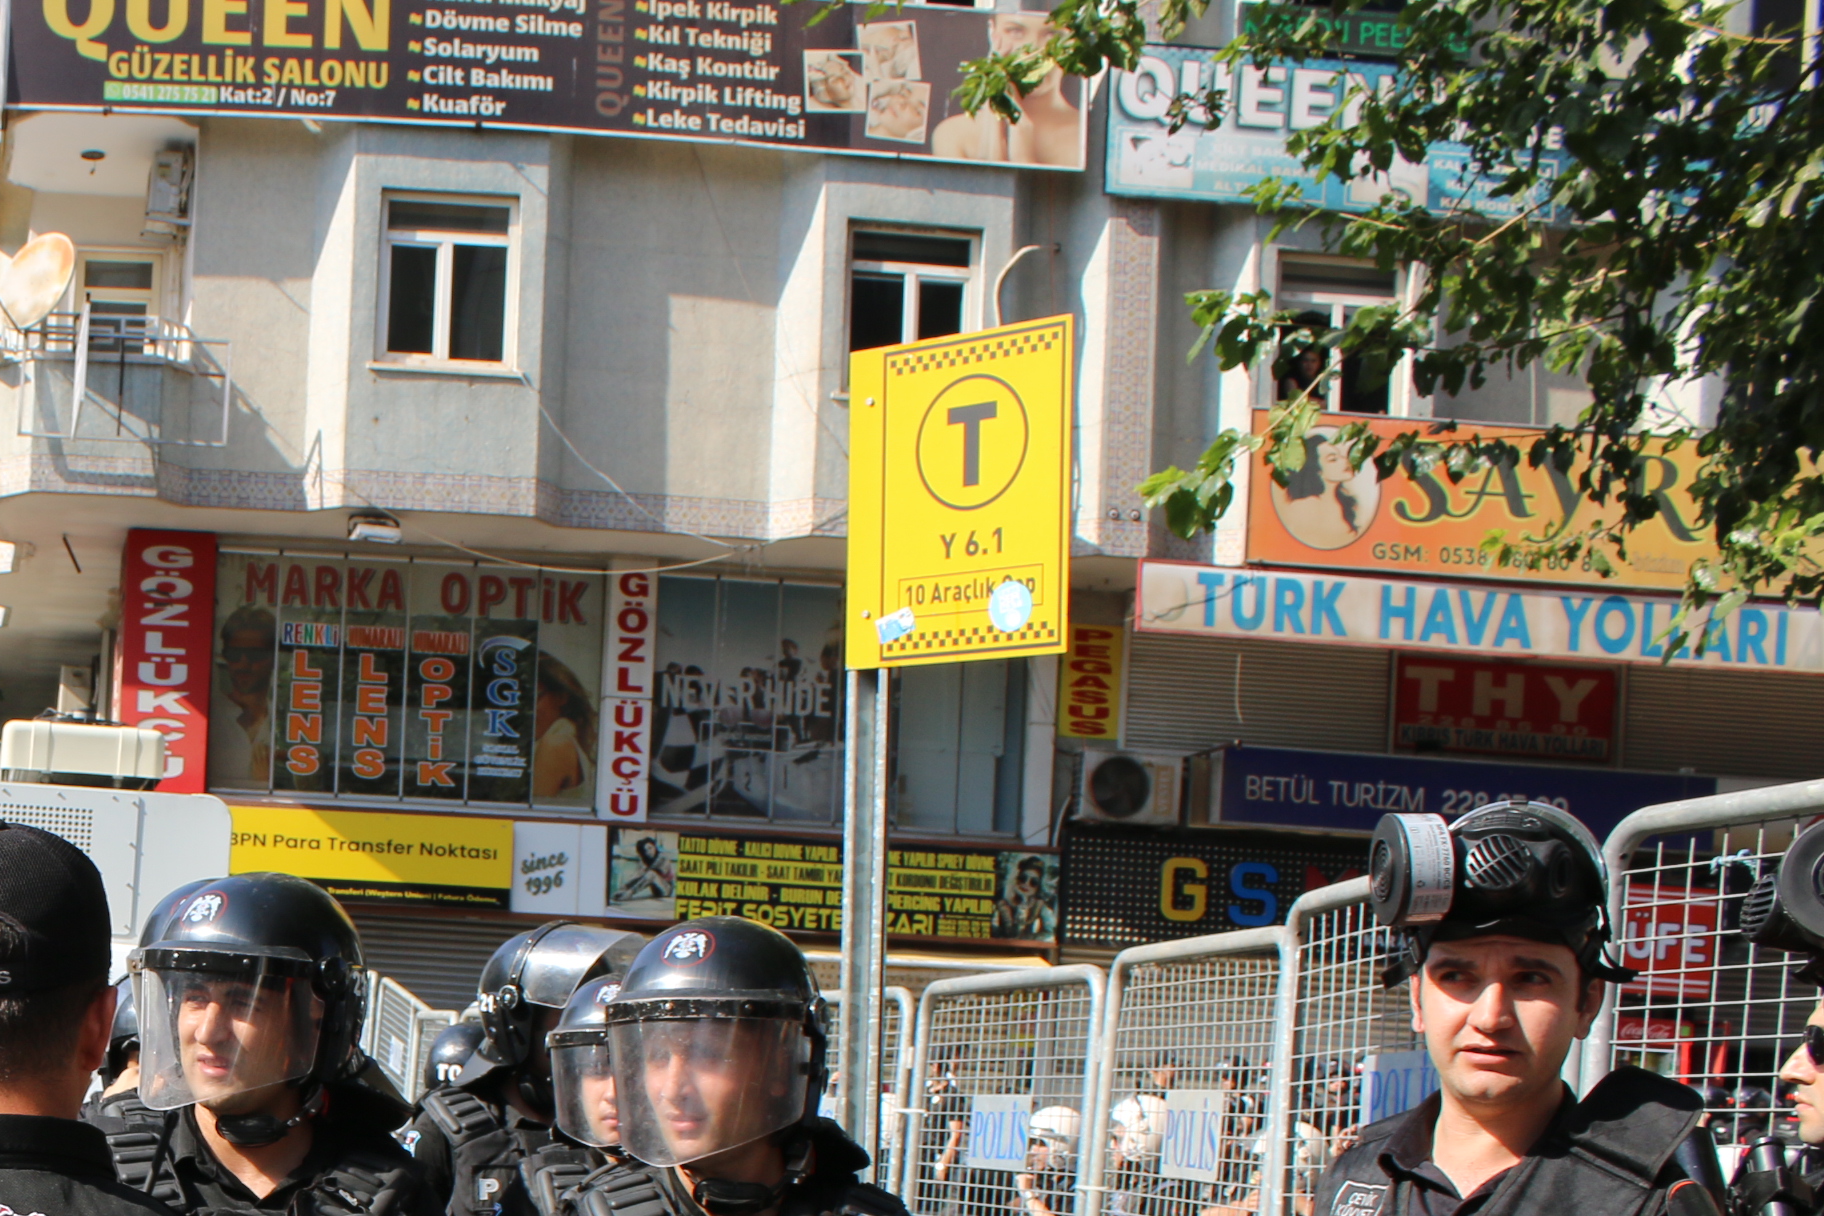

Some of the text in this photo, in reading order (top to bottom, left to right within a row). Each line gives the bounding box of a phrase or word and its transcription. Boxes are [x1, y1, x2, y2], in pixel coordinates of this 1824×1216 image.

[42, 0, 389, 62] QUEEN
[424, 9, 583, 38] Dövme Silme
[705, 1, 778, 26] Kirpik
[422, 37, 540, 64] Solaryum
[648, 25, 772, 56] Kıl Tekniği
[108, 46, 389, 90] GÜZELLİK SALONU
[422, 65, 554, 91] Cilt Bakımı
[647, 54, 780, 82] Kaş Kontür
[219, 86, 273, 106] Kat:2
[290, 88, 336, 107] No:7
[422, 92, 507, 116] Kuaför
[646, 81, 802, 116] Kirpik Lifting
[646, 108, 806, 139] Leke Tedavisi
[946, 400, 998, 487] T
[940, 527, 1004, 560] Y 6.1
[245, 560, 405, 613] MARKA
[906, 583, 925, 606] 10
[930, 576, 995, 604] Araçlık
[1196, 570, 1788, 667] TÜRK HAVA YOLLARI
[483, 648, 522, 738] SGK
[609, 573, 651, 817] GÖZLÜKÇÜ
[661, 672, 756, 711] NEVER
[1068, 630, 1115, 736] PEGASUS
[1404, 665, 1600, 724] THY
[286, 649, 323, 776] LENS
[352, 653, 389, 779] LENS
[1245, 774, 1321, 806] BETÜL
[1328, 778, 1425, 813] TURİZM
[273, 833, 321, 851] Para
[327, 836, 415, 856] Transfer
[419, 840, 499, 861] Noktası
[521, 851, 569, 875] since
[524, 871, 565, 895] 1996
[677, 880, 720, 898] KULAK
[886, 911, 935, 936] ZARI
[1626, 911, 1709, 963] ÜFE
[975, 1099, 1029, 1161] POLİS
[1166, 1095, 1219, 1172] POLİS
